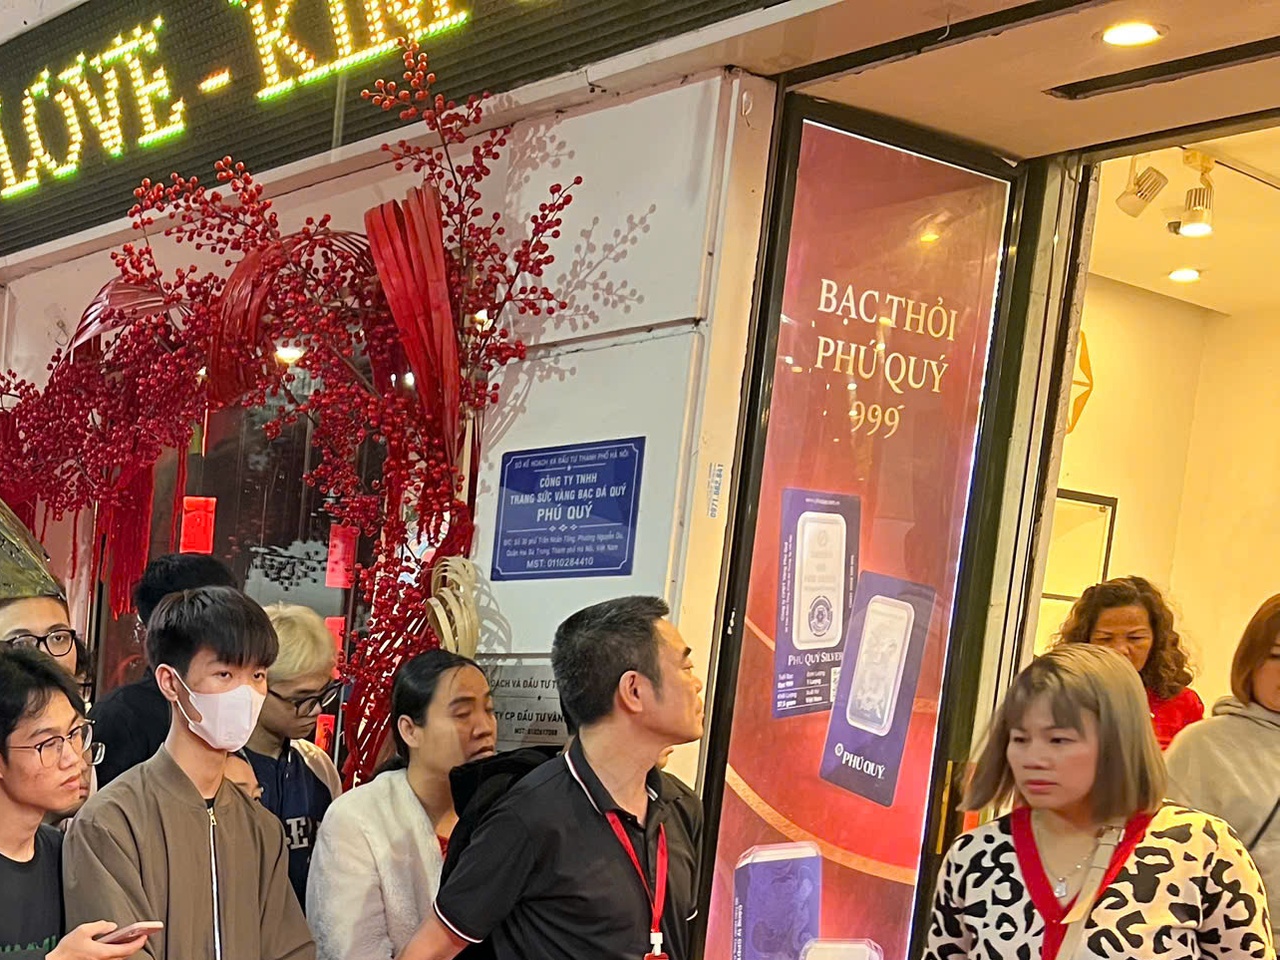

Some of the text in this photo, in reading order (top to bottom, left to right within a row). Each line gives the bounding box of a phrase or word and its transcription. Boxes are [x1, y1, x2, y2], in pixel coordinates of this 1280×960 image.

[817, 278, 959, 342] BẠC THỎI
[814, 335, 949, 394] PHÚ QUÝ
[849, 401, 900, 439] 999
[540, 473, 598, 489] CÔNG TY TNHH
[510, 482, 627, 505] TRANG SỨC VÀNG BẠC ĐÁ QUÝ
[536, 500, 593, 522] PHÚ QUÝ
[511, 677, 521, 688] VÀ
[522, 676, 539, 689] ĐẦU
[540, 679, 551, 689] TƯ
[505, 711, 516, 721] CP
[517, 709, 534, 722] ĐẦU
[547, 711, 564, 723] VÀN
[842, 750, 886, 780] PHÚ QUÝ
